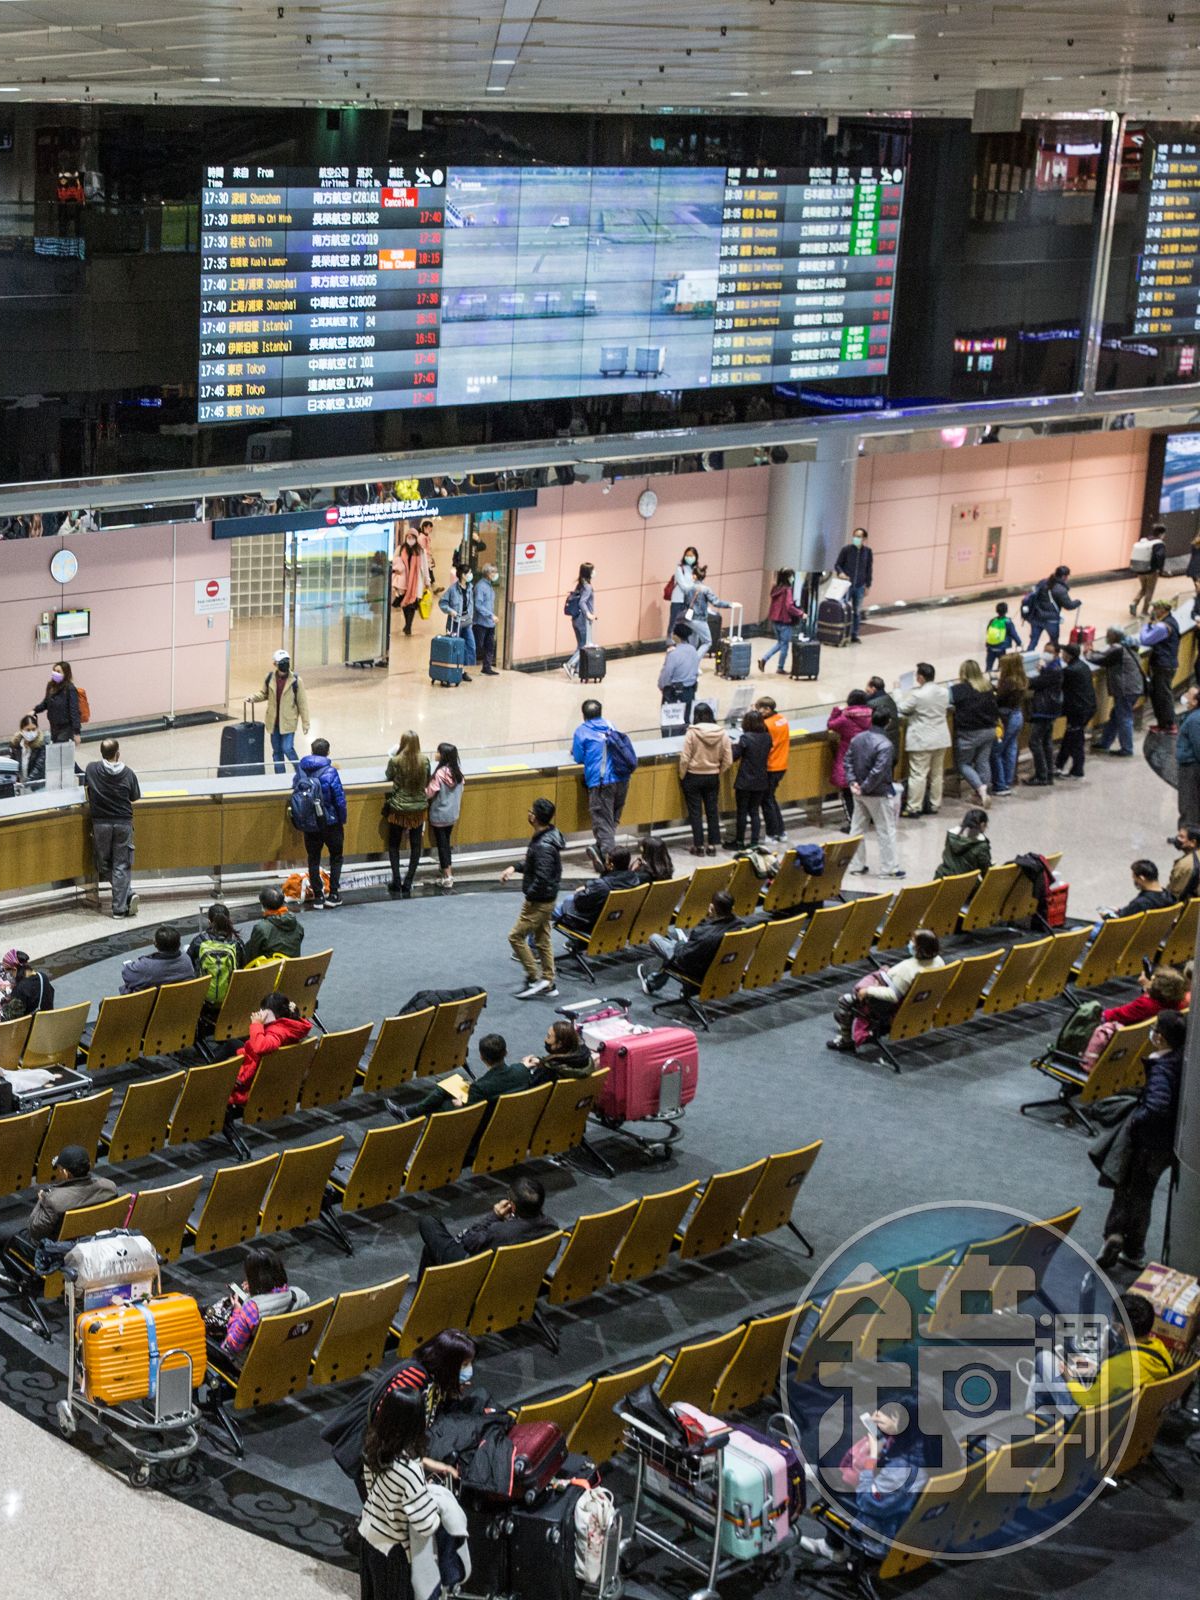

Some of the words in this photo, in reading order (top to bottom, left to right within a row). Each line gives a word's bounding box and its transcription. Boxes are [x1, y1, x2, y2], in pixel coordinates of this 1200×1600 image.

[204, 192, 228, 205] 17:30
[250, 192, 281, 205] Shenzhen
[204, 214, 228, 226] 17:30
[204, 236, 228, 248] 17:30
[249, 236, 272, 248] Guilin
[203, 257, 227, 270] 17:35
[202, 300, 226, 313] 17:40
[202, 322, 226, 334] 17:40
[262, 319, 292, 332] Istanbul
[200, 385, 224, 398] 17:45
[246, 383, 266, 396] Tokyo
